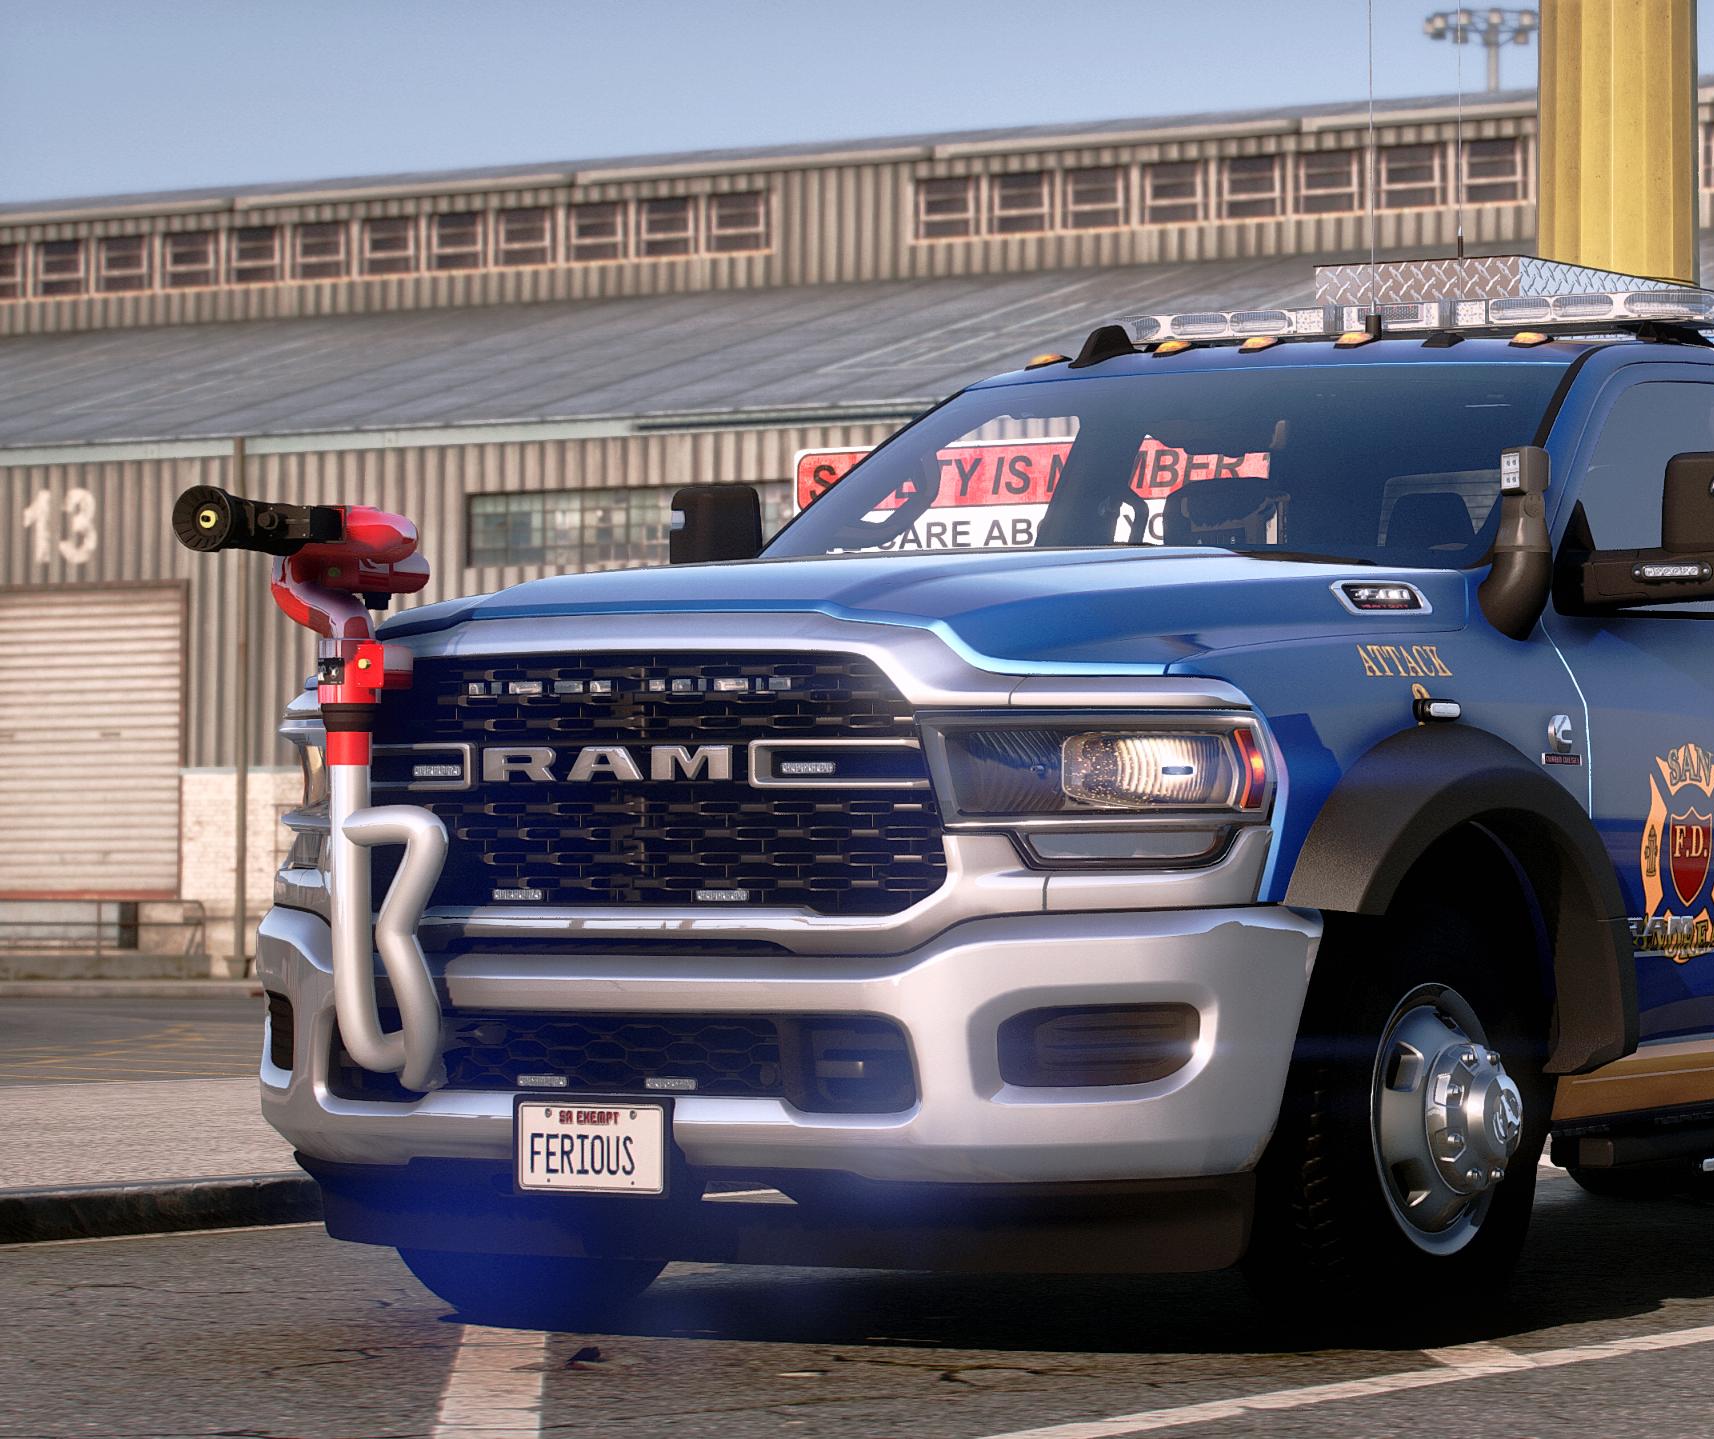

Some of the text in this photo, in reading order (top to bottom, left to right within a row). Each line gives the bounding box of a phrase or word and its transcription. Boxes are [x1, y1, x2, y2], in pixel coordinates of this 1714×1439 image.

[991, 455, 1033, 495] IS
[23, 488, 98, 564] 13
[1357, 644, 1453, 677] ATTACK
[482, 746, 733, 782] RAM
[1667, 746, 1714, 786] SAN
[1673, 825, 1708, 858] F.D.
[559, 1110, 620, 1126] SA EXEMPT
[530, 1132, 635, 1176] FERIOUS
